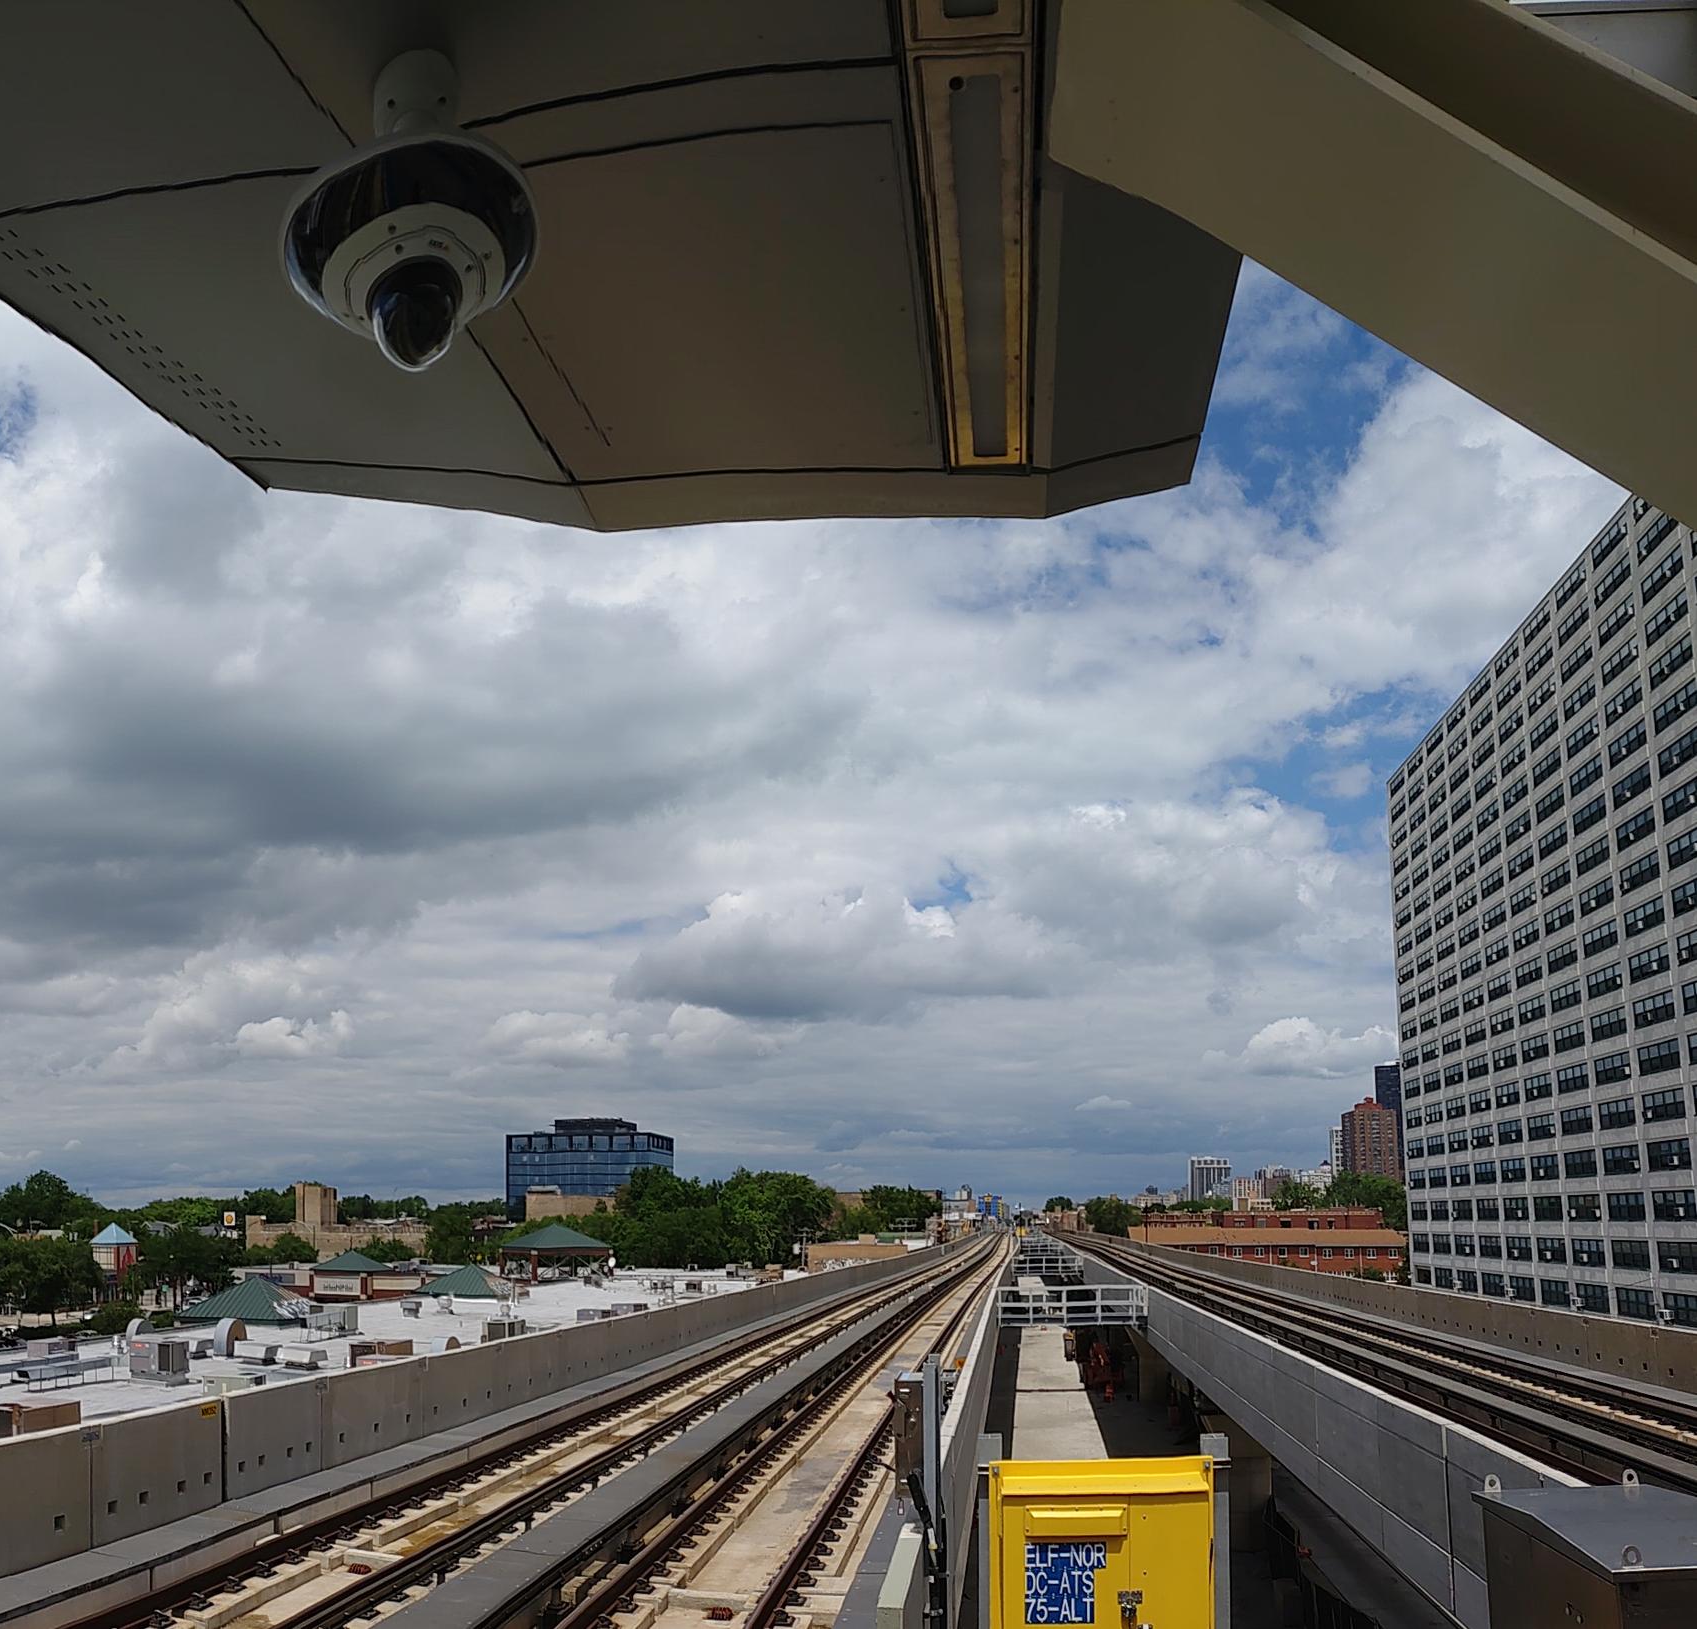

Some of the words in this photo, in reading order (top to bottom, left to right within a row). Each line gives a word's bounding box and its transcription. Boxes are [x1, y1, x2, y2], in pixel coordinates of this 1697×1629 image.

[1025, 1544, 1106, 1567] ELF-NOR
[1025, 1571, 1094, 1595] DC-ATS
[1025, 1598, 1094, 1622] 75-ALT
